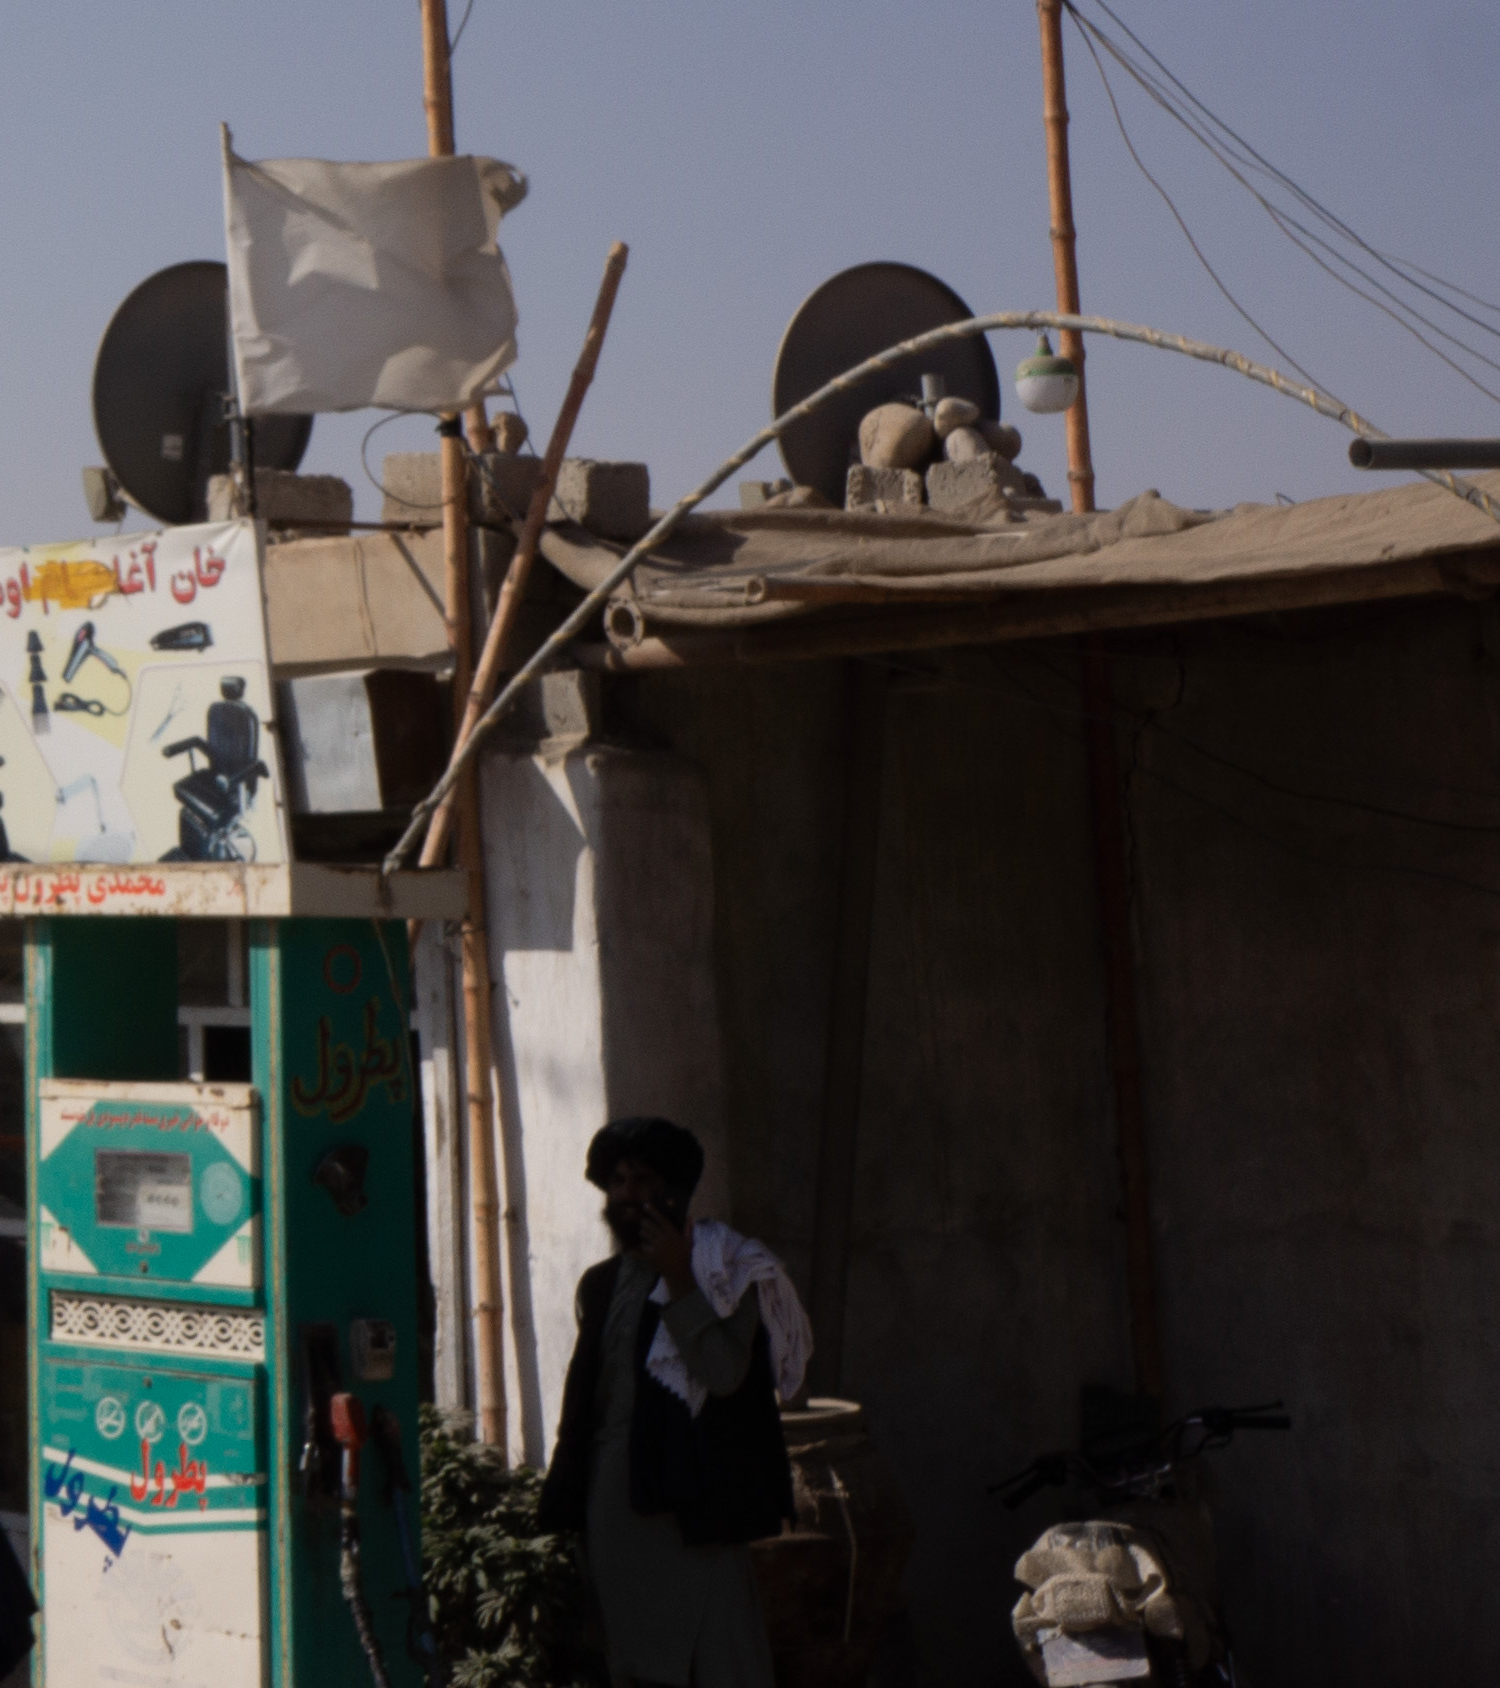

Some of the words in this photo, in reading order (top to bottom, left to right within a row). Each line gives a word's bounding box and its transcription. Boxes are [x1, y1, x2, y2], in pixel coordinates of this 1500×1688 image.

[170, 544, 225, 604] خان
[290, 995, 407, 1124] پطرول
[130, 1437, 208, 1513] پطرول
